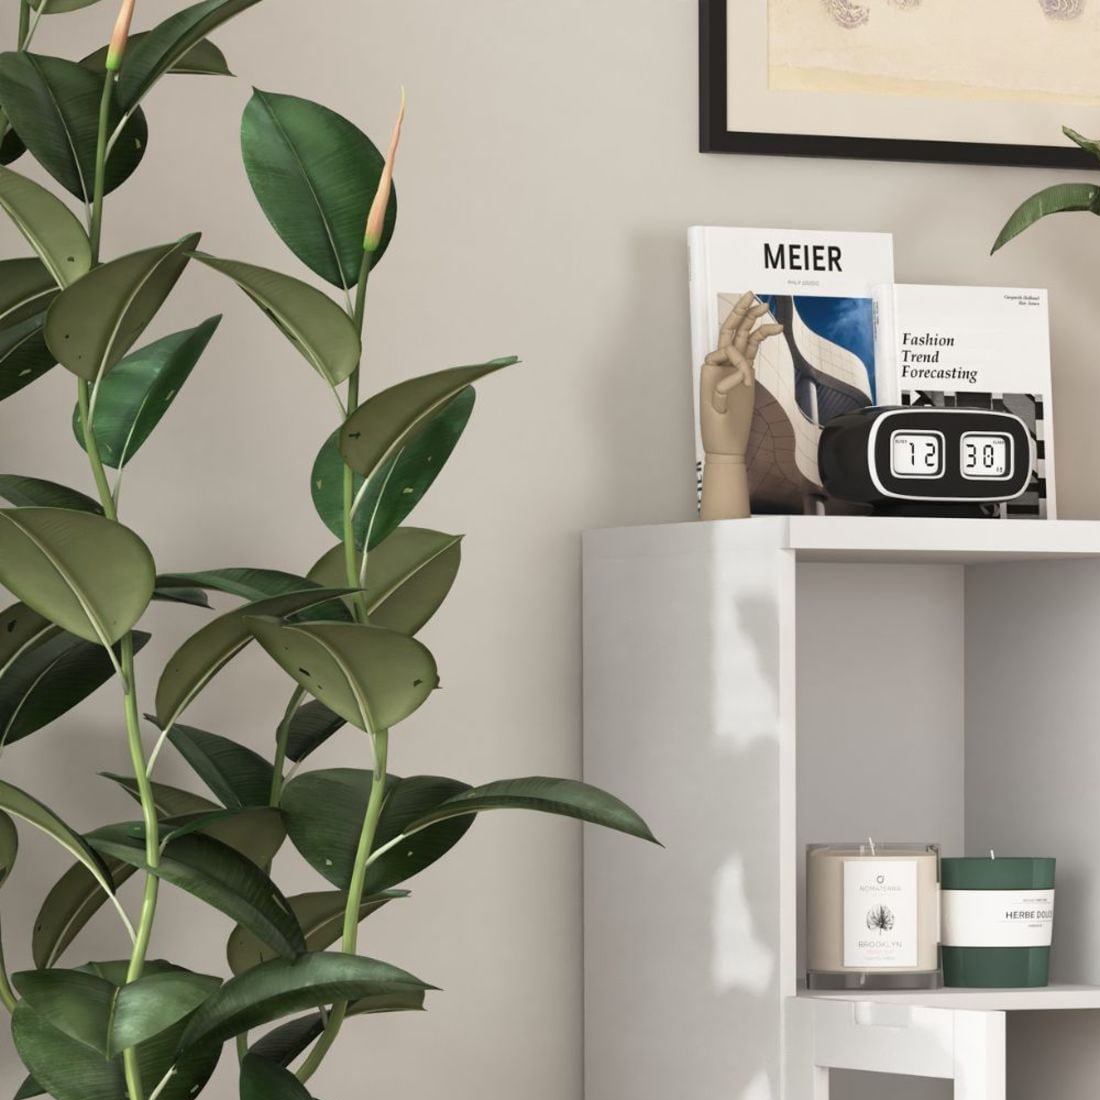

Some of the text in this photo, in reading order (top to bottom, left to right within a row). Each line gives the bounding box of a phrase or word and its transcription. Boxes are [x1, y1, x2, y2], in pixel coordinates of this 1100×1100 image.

[763, 243, 842, 272] MEIER
[902, 332, 955, 347] Fashion
[902, 350, 940, 363] Trend
[902, 365, 978, 384] Forecasting
[909, 442, 936, 467] 12
[966, 443, 994, 468] 30
[1005, 911, 1035, 919] HERBE
